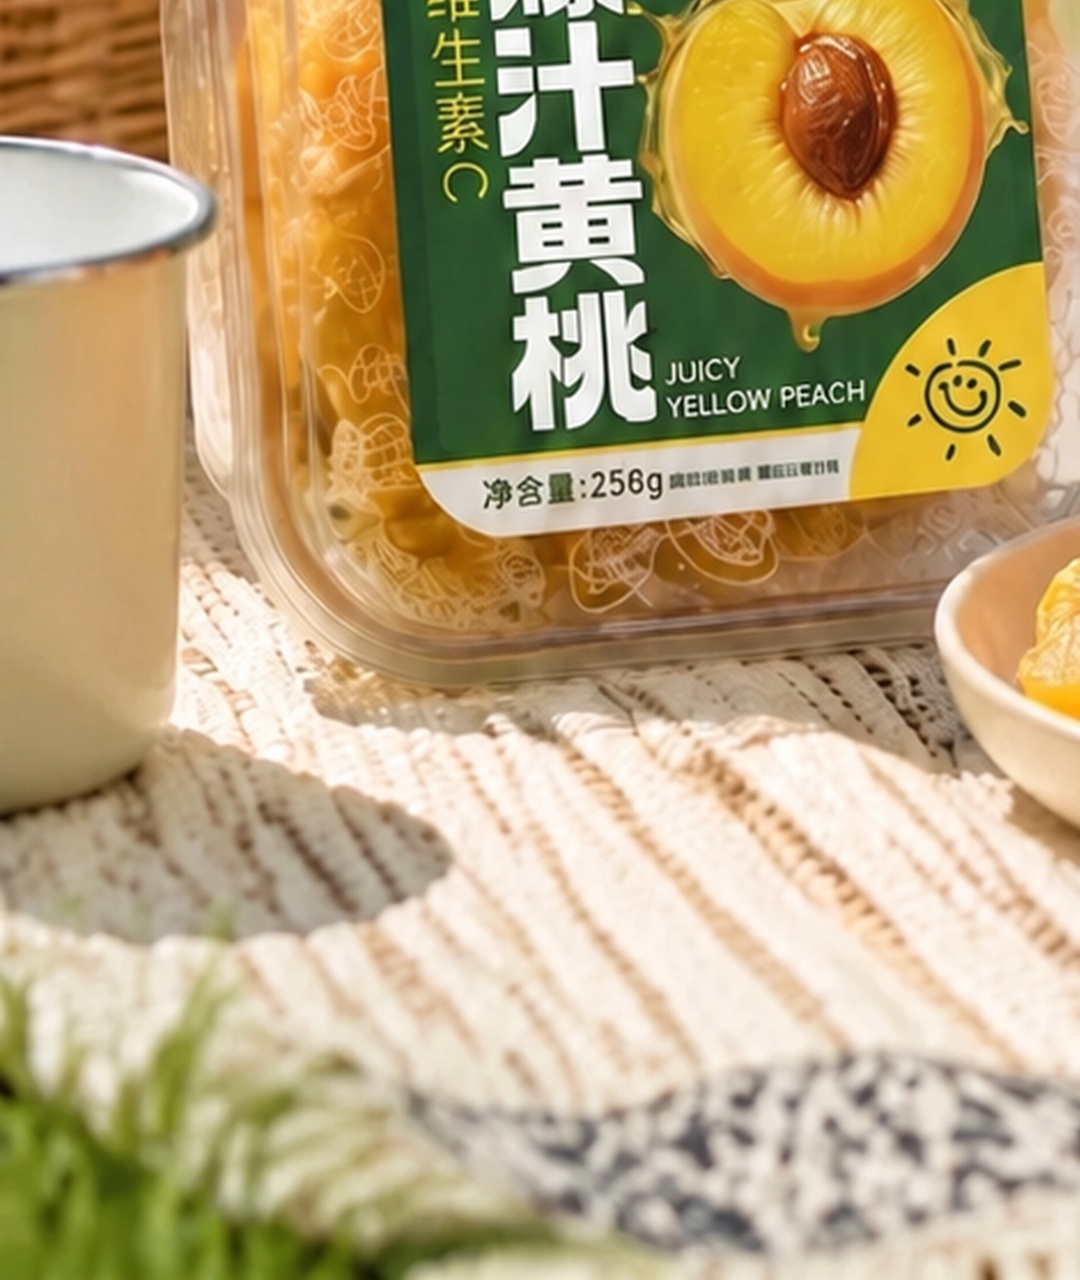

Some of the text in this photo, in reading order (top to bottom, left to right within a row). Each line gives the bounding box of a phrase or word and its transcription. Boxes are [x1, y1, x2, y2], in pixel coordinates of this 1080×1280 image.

[665, 356, 741, 386] JUICY
[666, 379, 866, 418] YELLOW PEACH
